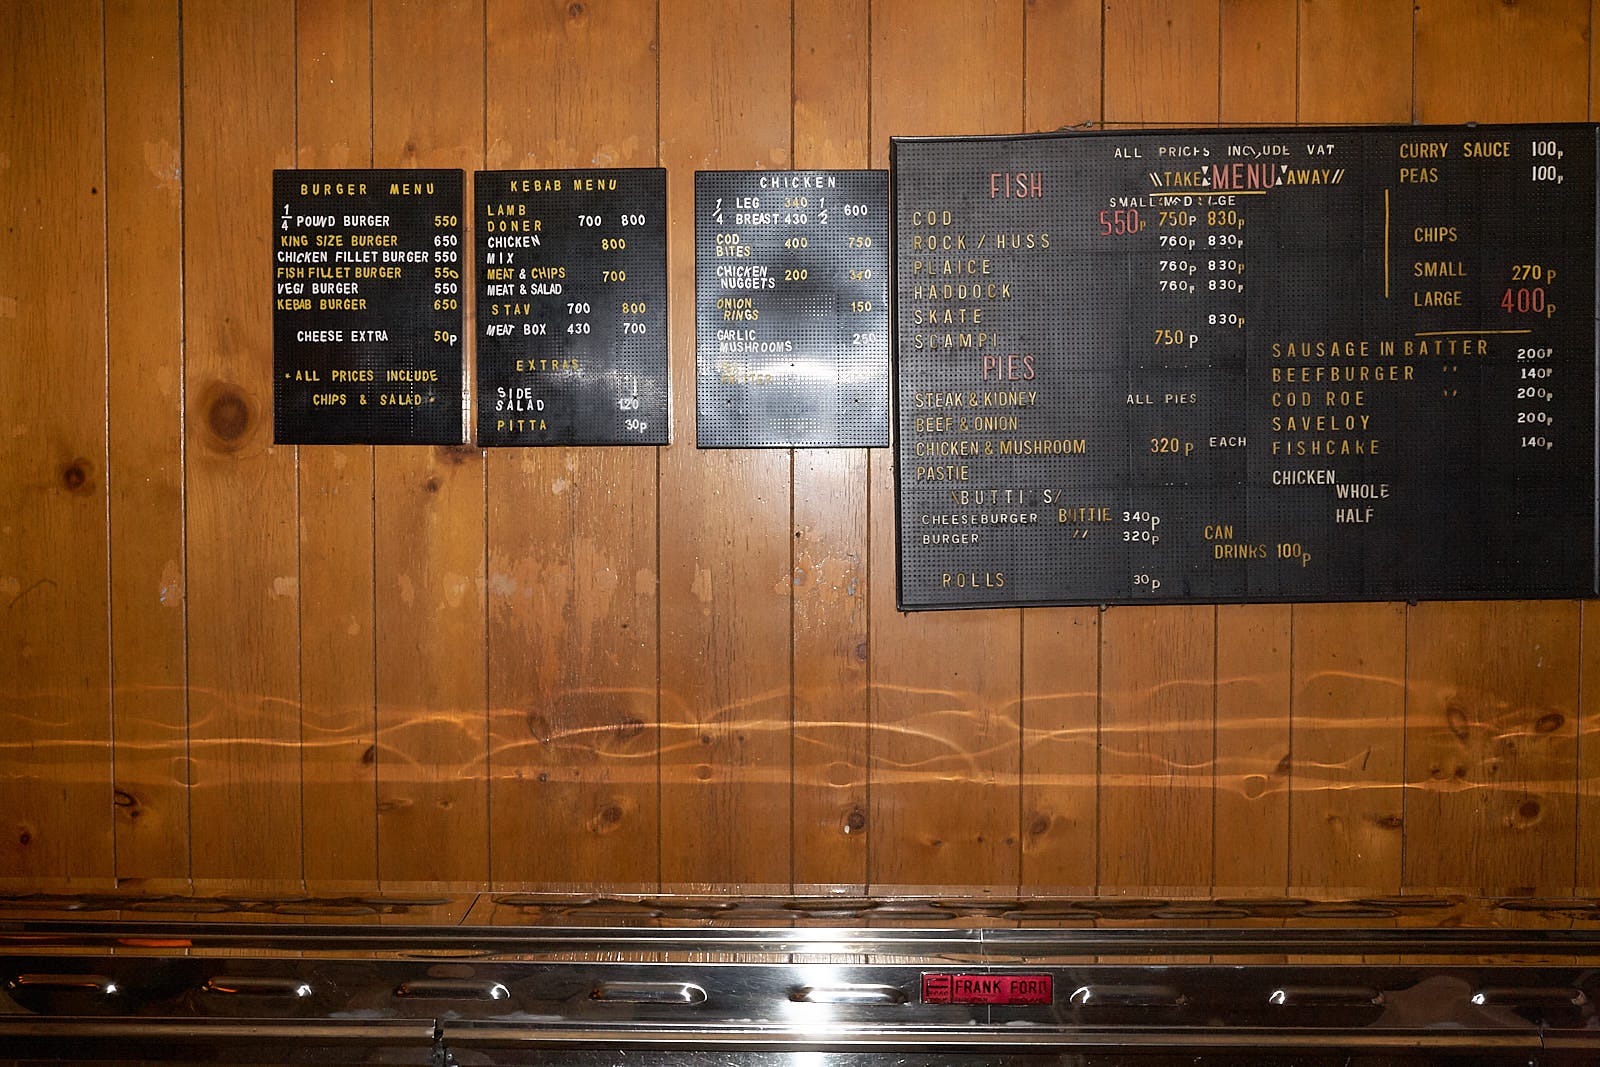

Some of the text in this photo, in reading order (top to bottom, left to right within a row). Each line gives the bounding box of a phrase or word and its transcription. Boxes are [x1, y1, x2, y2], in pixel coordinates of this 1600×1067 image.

[1114, 148, 1142, 158] ALL
[1307, 144, 1335, 155] VAT
[1400, 143, 1448, 158] CURRY
[1463, 142, 1511, 157] SAUCE
[760, 177, 835, 188] CHICKEN
[1164, 171, 1201, 187] TAKE
[1212, 163, 1275, 189] MENU
[1400, 168, 1438, 183] PEAS
[300, 183, 434, 195] BURGER MENU
[511, 179, 617, 192] KEBAB MENU
[991, 172, 1043, 198] FISH
[487, 204, 526, 216] LAMB
[736, 197, 868, 215] LEG 340 600
[1110, 197, 1156, 208] SMALL
[297, 215, 457, 227] POUND BURGER 550
[488, 214, 645, 232] DONER 700 800
[735, 214, 807, 225] BREAST 430
[913, 211, 951, 226] COD
[281, 235, 457, 246] KING SIZE BURGER 650
[717, 234, 871, 248] COD 400 750
[913, 235, 966, 250] ROCK
[997, 233, 1050, 249] HUSS
[1414, 227, 1457, 242] CHIPS
[488, 235, 626, 250] CHICKEN 800
[277, 251, 457, 263] CHICKEN FILLET BURGER 550
[487, 252, 514, 264] MIX
[717, 246, 751, 257] BITES
[277, 267, 459, 279] FISH FILLET BURGER 550
[487, 267, 626, 282] MEAT & CHIPS 700
[717, 266, 871, 281] CHICKEN 200 340
[914, 259, 990, 275] PLAICE
[1414, 261, 1467, 277] SMALL
[277, 283, 457, 295] VEGI BURGER 550
[487, 283, 562, 296] MEAT & SALAD
[721, 277, 776, 289] NUGGETS
[914, 284, 1011, 300] HADDOCK
[1414, 291, 1462, 306] LARGE
[277, 299, 457, 310] KEBAB BURGER 650
[491, 303, 646, 315] STAV 700 800
[717, 299, 871, 313] ONION 150
[724, 310, 759, 321] RINGS
[914, 309, 982, 325] SKATE
[297, 330, 343, 342] CHEESE
[351, 330, 388, 342] EXTRA
[486, 323, 646, 336] MEAT BOX 430 700
[717, 330, 756, 341] GARLIC
[720, 341, 793, 353] MUSHROOMS
[915, 333, 997, 349] SCAMPI
[1272, 340, 1488, 358] SAUSAGE IN BATTER
[516, 359, 579, 372] EXTRAS
[983, 355, 1035, 381] PIES
[296, 370, 438, 382] ALL PRICES INCLUDE
[1272, 366, 1414, 382] BEEFBURGER
[313, 394, 422, 405] CHIPS & SALAD
[497, 387, 532, 399] SIDE
[915, 392, 963, 408] STEAK
[984, 391, 1037, 406] KIDNEY
[1126, 394, 1197, 405] ALL PIES
[1272, 391, 1364, 407] COD ROE
[496, 399, 544, 411] SALAD
[497, 420, 547, 432] PITTA
[916, 417, 953, 432] BEEF
[974, 416, 1017, 431] ONION
[1272, 415, 1370, 432] SAVELOY
[916, 441, 979, 456] CHICKEN
[1000, 440, 1086, 455] MUSHROOM
[1209, 437, 1247, 447] EACH
[1272, 440, 1380, 456] FISHCAKE
[917, 466, 969, 481] PASTIE
[1272, 470, 1335, 485] CHICKEN
[1336, 484, 1390, 499] WHOLE
[922, 513, 1038, 525] CHEESEBURGER
[1058, 508, 1112, 523] BUTTIE
[1336, 508, 1374, 523] HALF
[923, 534, 979, 545] BURGER
[1204, 525, 1233, 540] CAN
[1214, 544, 1267, 559] DRINKS
[942, 573, 1004, 588] ROLLS
[956, 980, 1000, 993] FRANK
